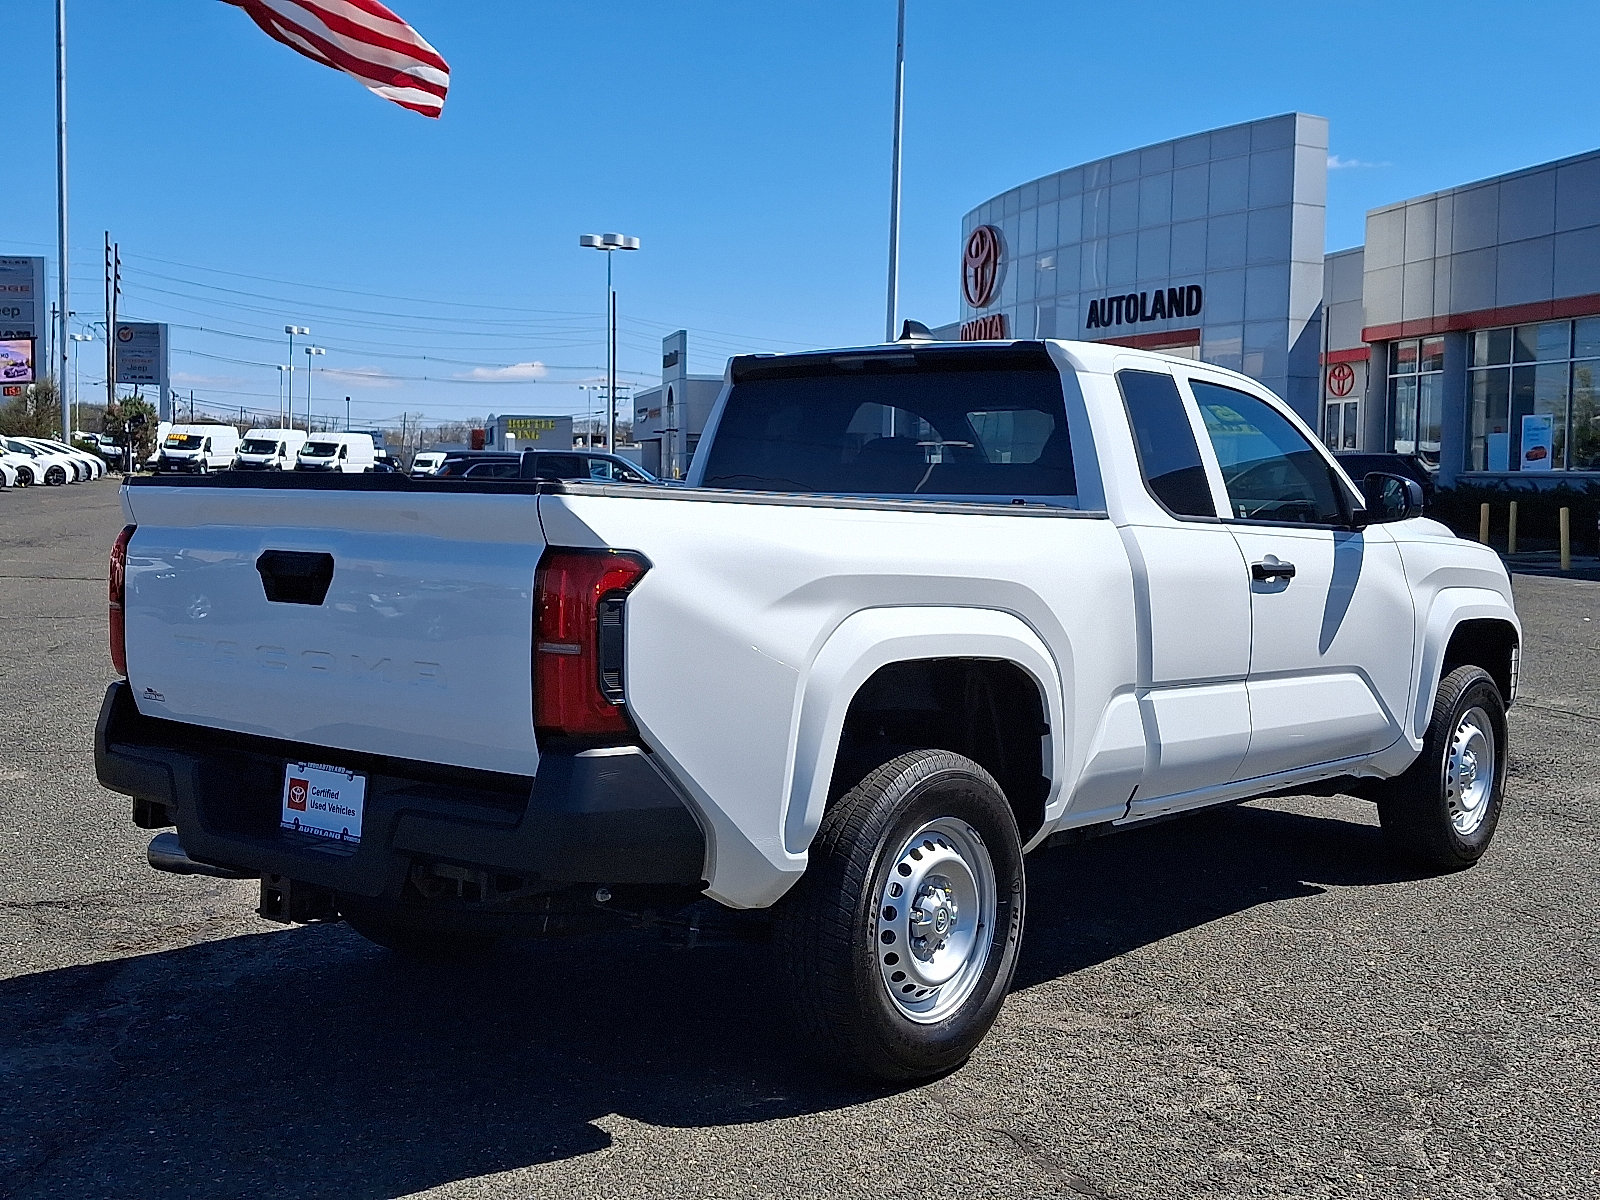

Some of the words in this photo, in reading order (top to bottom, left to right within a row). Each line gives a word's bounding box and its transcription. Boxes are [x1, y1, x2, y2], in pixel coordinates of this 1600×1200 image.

[0, 306, 20, 318] ep
[1086, 284, 1202, 329] AUTOLAND
[508, 430, 539, 440] ING
[312, 786, 340, 800] Certified
[311, 800, 327, 811] Used
[328, 802, 356, 817] Vehicles
[298, 826, 341, 840] AUTOLAND
